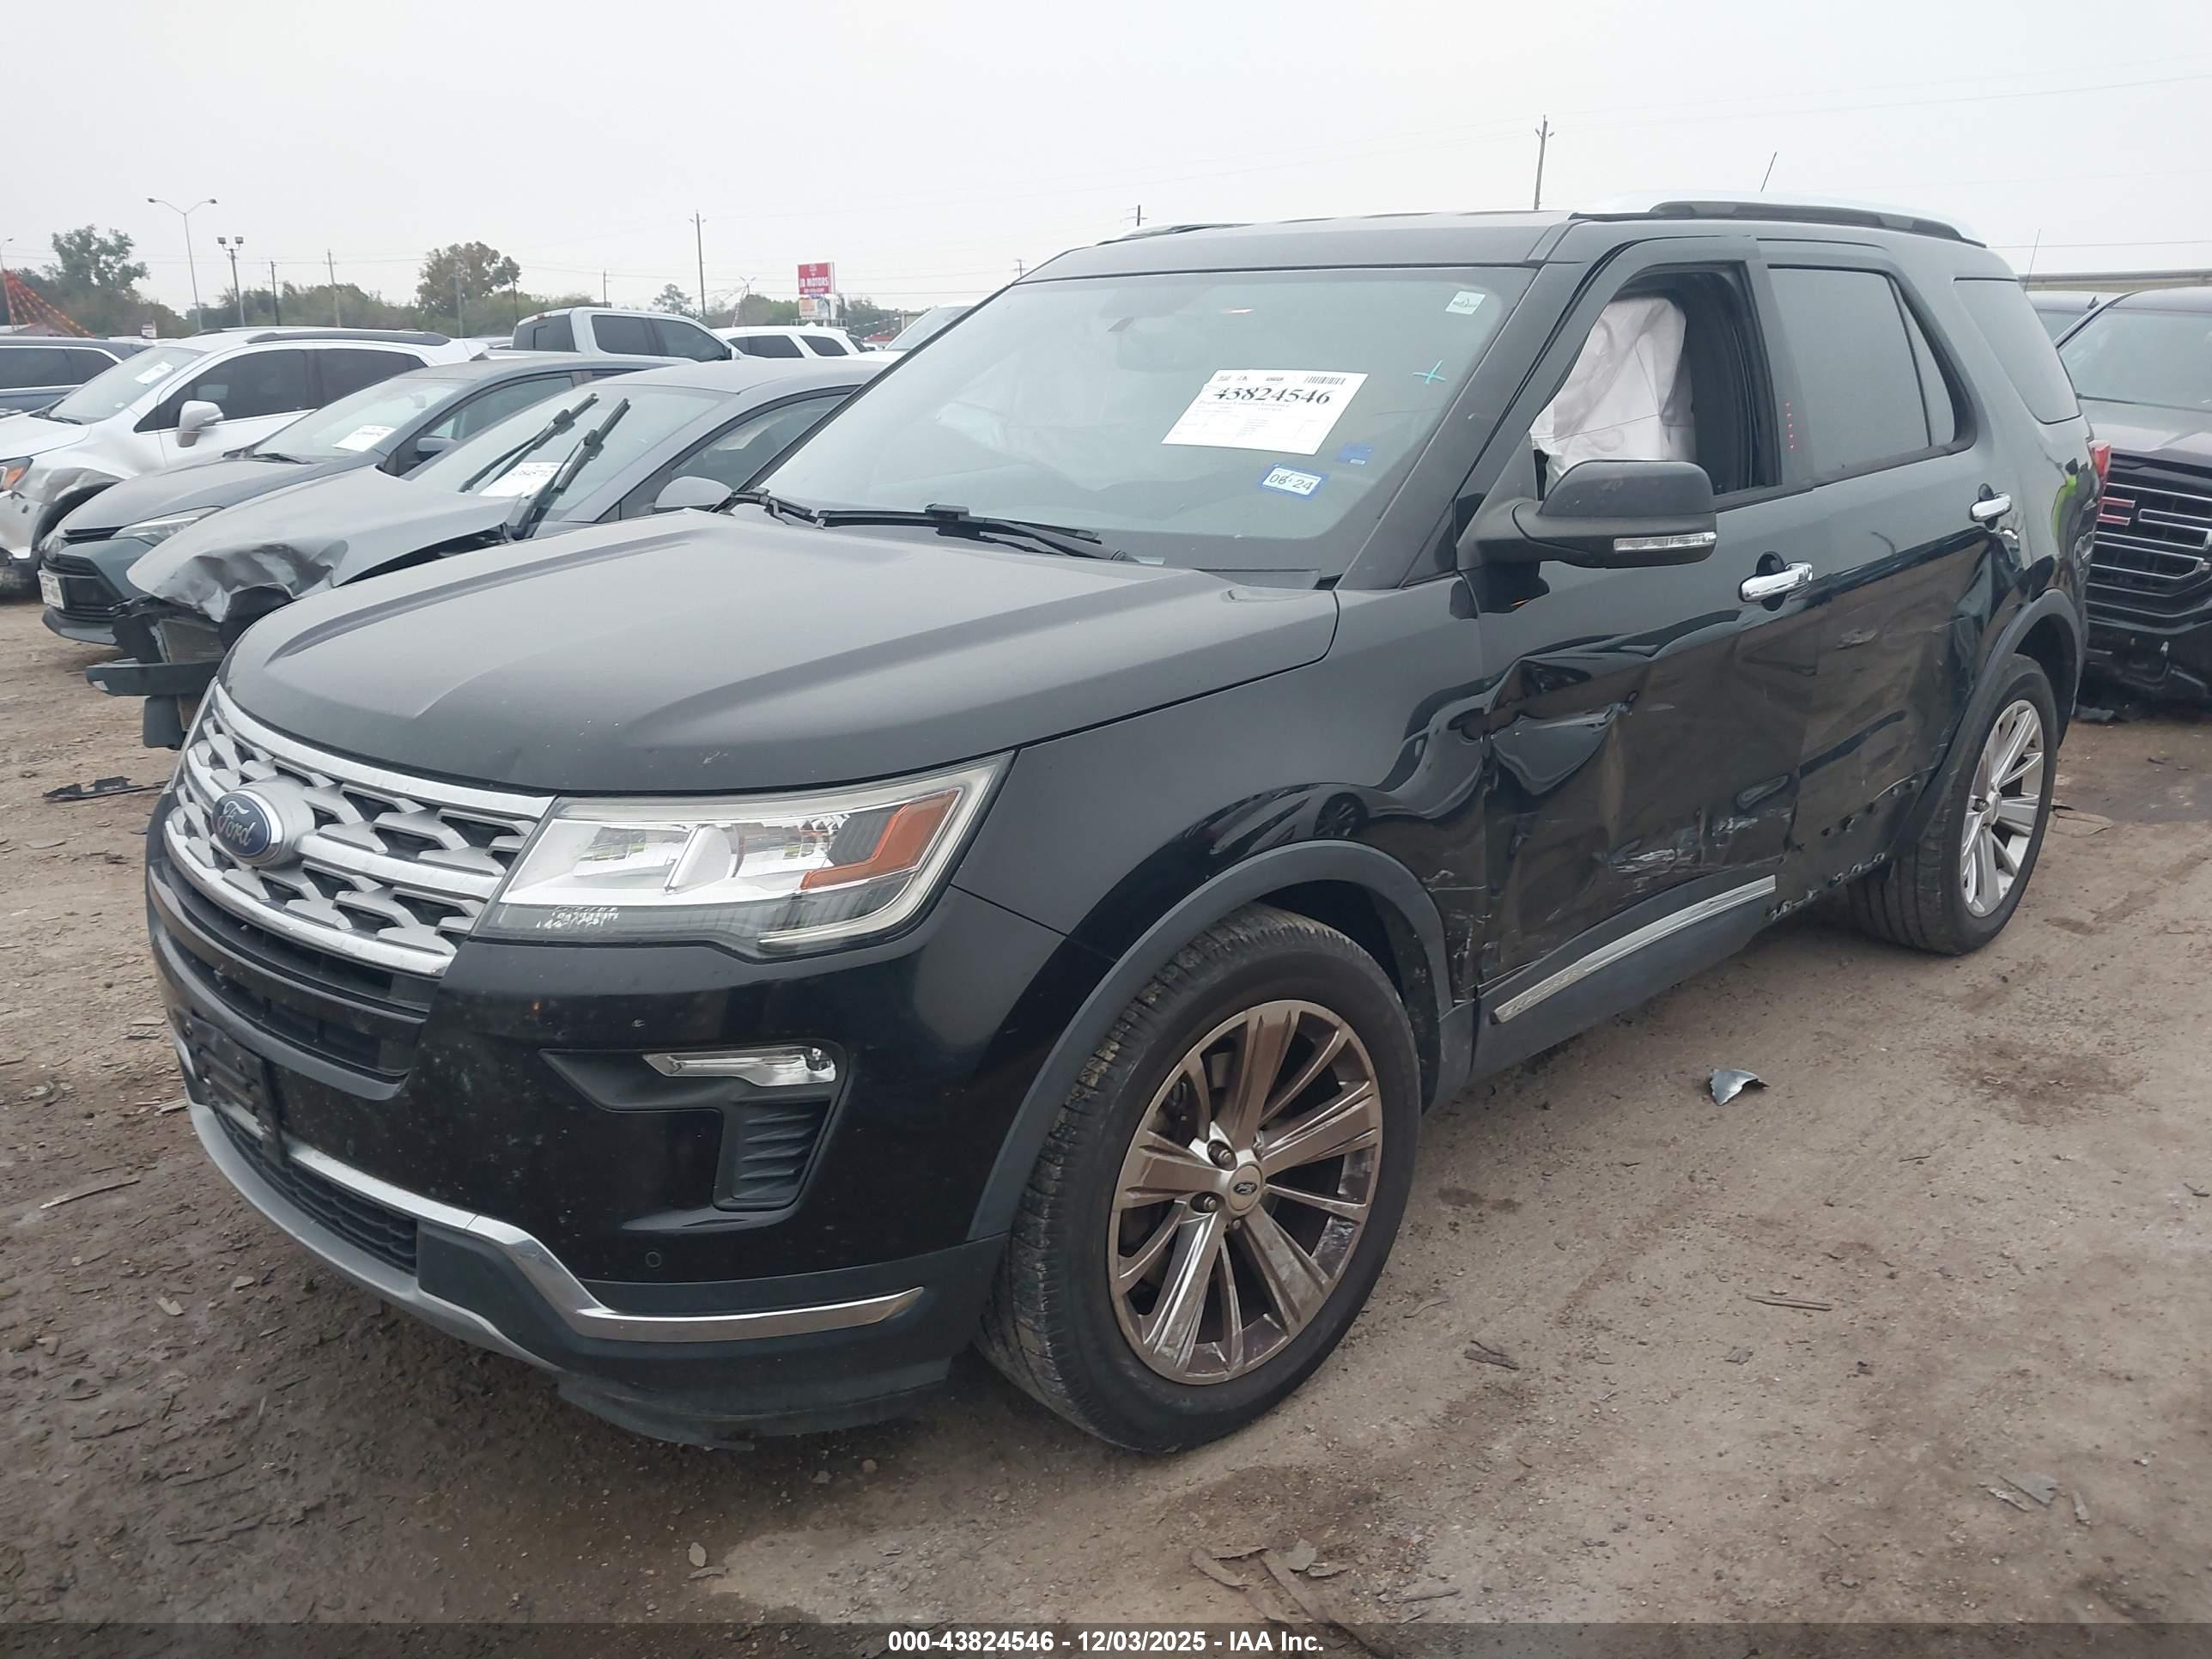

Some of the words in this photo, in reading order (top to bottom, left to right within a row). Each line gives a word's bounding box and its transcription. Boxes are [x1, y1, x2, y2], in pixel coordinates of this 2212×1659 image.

[1213, 386, 1335, 405] 43824546
[1292, 479, 1314, 491] 24
[217, 800, 257, 847] Ford
